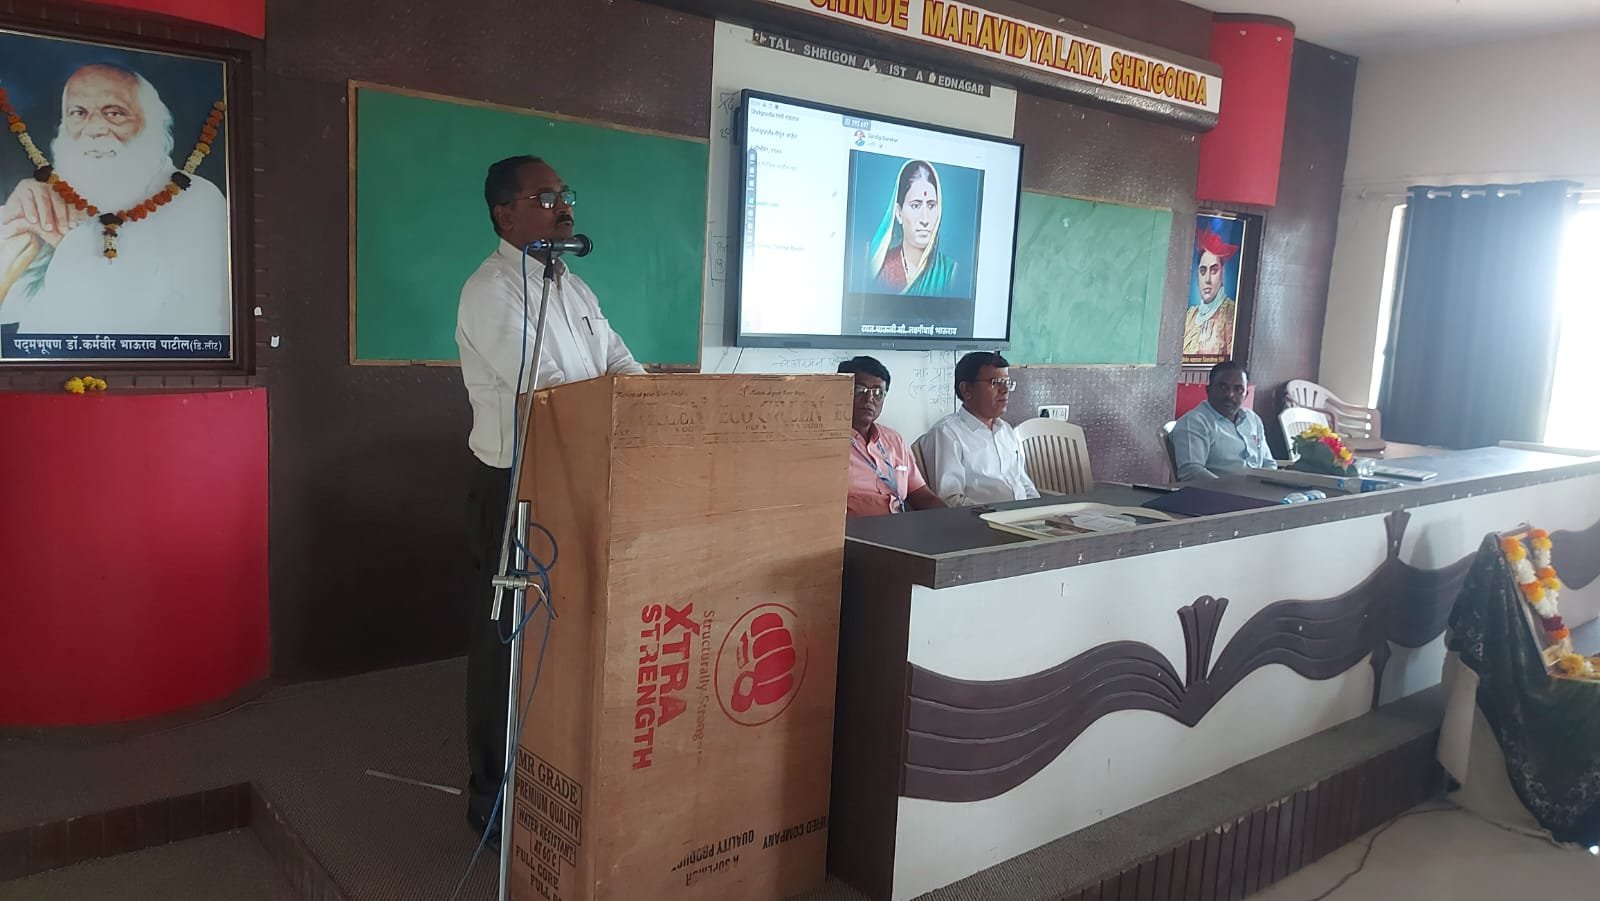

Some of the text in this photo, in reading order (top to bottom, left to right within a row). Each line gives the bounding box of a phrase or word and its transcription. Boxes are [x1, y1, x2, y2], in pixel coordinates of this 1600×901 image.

[769, 36, 795, 53] TAL.
[811, 0, 909, 31] NDE
[1110, 51, 1208, 106] SHRIGONDA
[120, 339, 156, 350] भाऊराव
[632, 604, 662, 770] STRENGTH
[657, 602, 700, 727] XTRA
[518, 749, 578, 805] MR GRADE
[515, 775, 579, 838] PREMIUM QUALITY
[519, 807, 574, 861] WATER RESISTANT
[534, 840, 541, 856] AT
[717, 829, 754, 855] QUALITY
[763, 823, 804, 850] COMPANY
